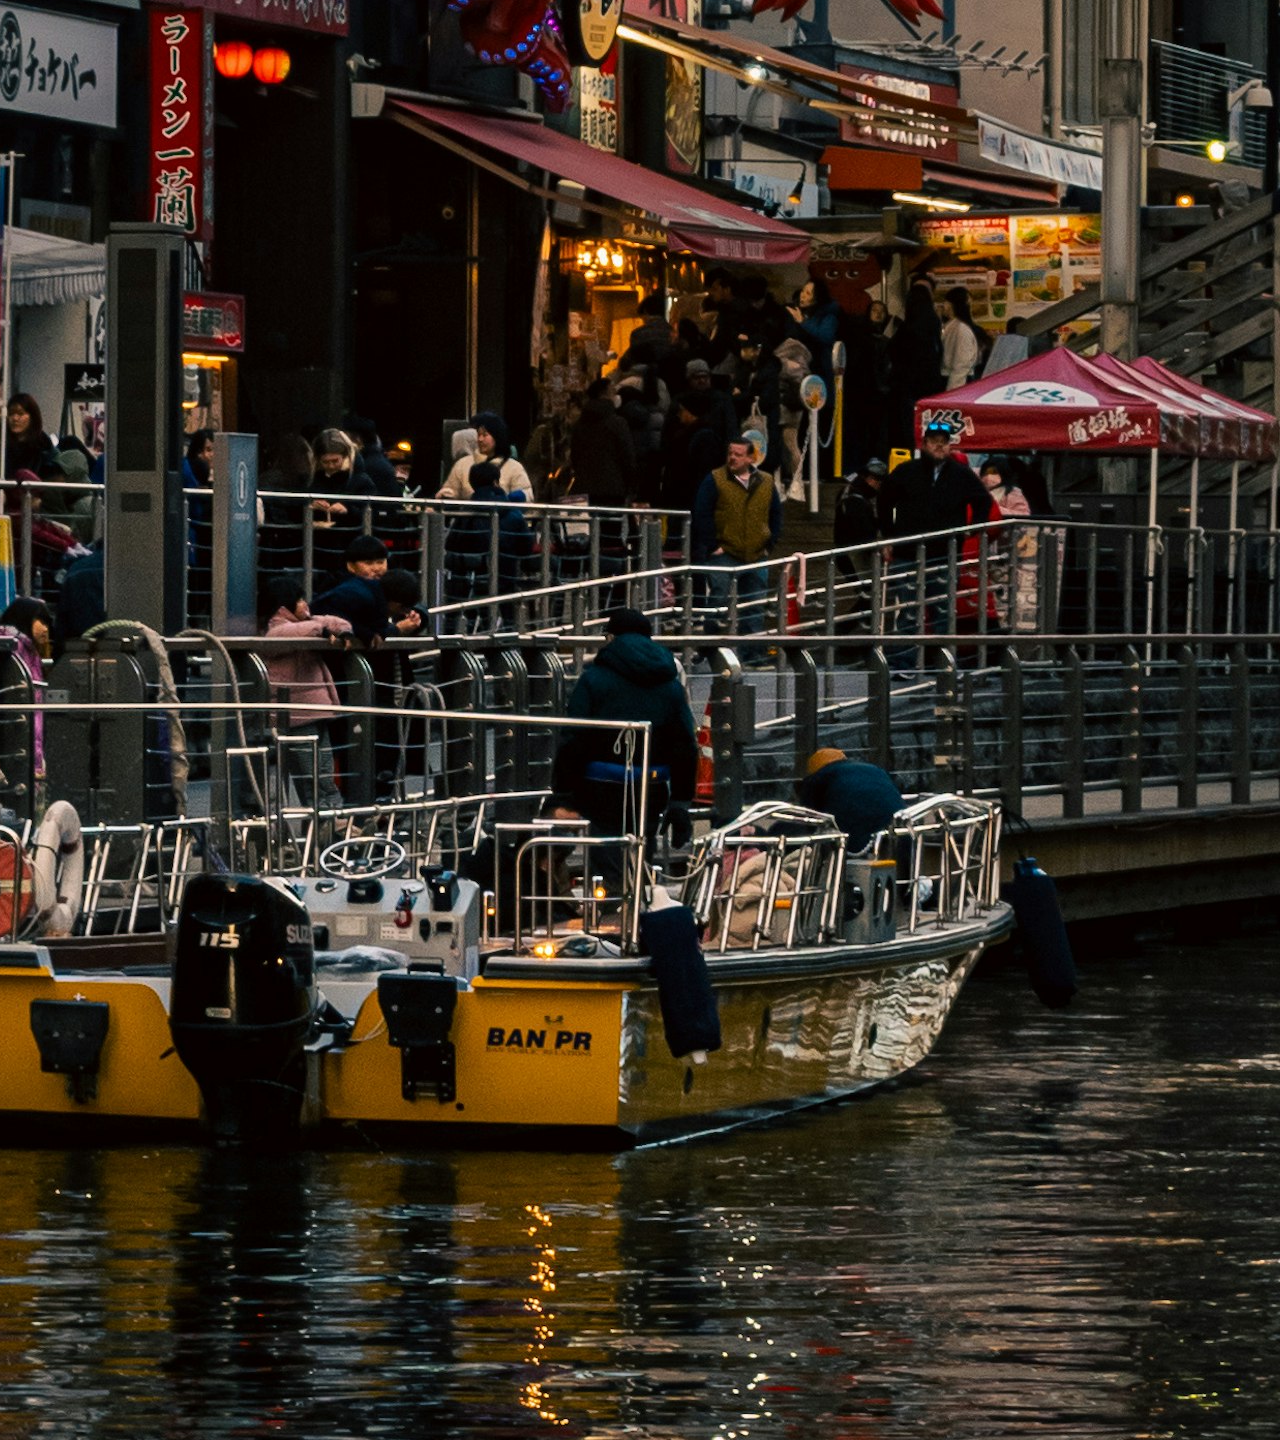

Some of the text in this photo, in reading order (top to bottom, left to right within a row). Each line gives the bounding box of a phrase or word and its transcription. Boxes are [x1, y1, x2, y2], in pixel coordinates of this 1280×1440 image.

[154, 13, 196, 233] ラーメン一蘭
[198, 931, 241, 949] 115
[487, 1027, 593, 1052] BAN PR
